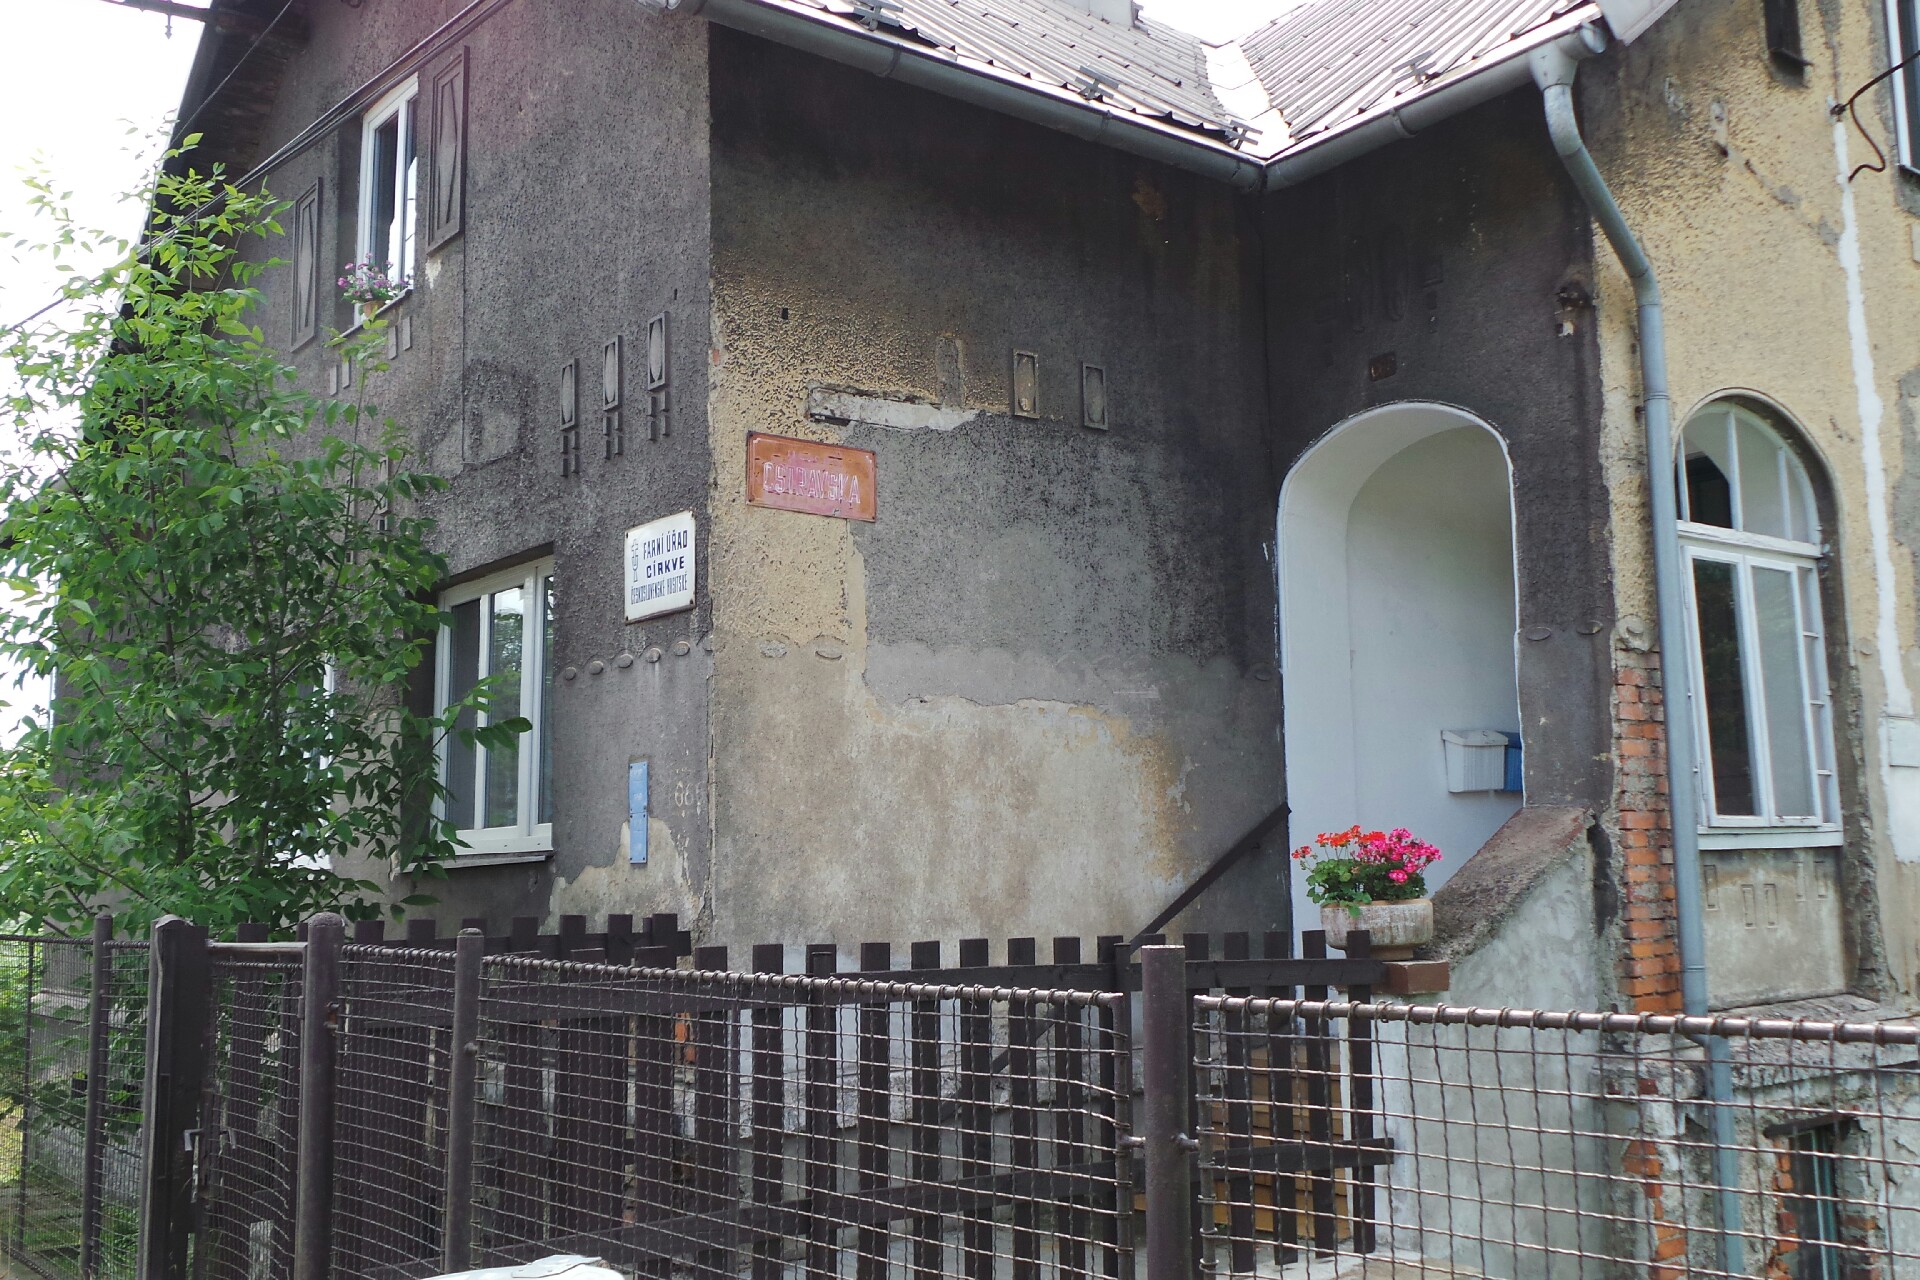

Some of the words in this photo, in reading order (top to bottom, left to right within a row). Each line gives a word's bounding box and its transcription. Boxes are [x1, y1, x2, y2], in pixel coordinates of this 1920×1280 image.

[643, 533, 664, 560] FARNÍ
[666, 529, 688, 552] ÚŘAD
[646, 556, 685, 579] CÍRKVE
